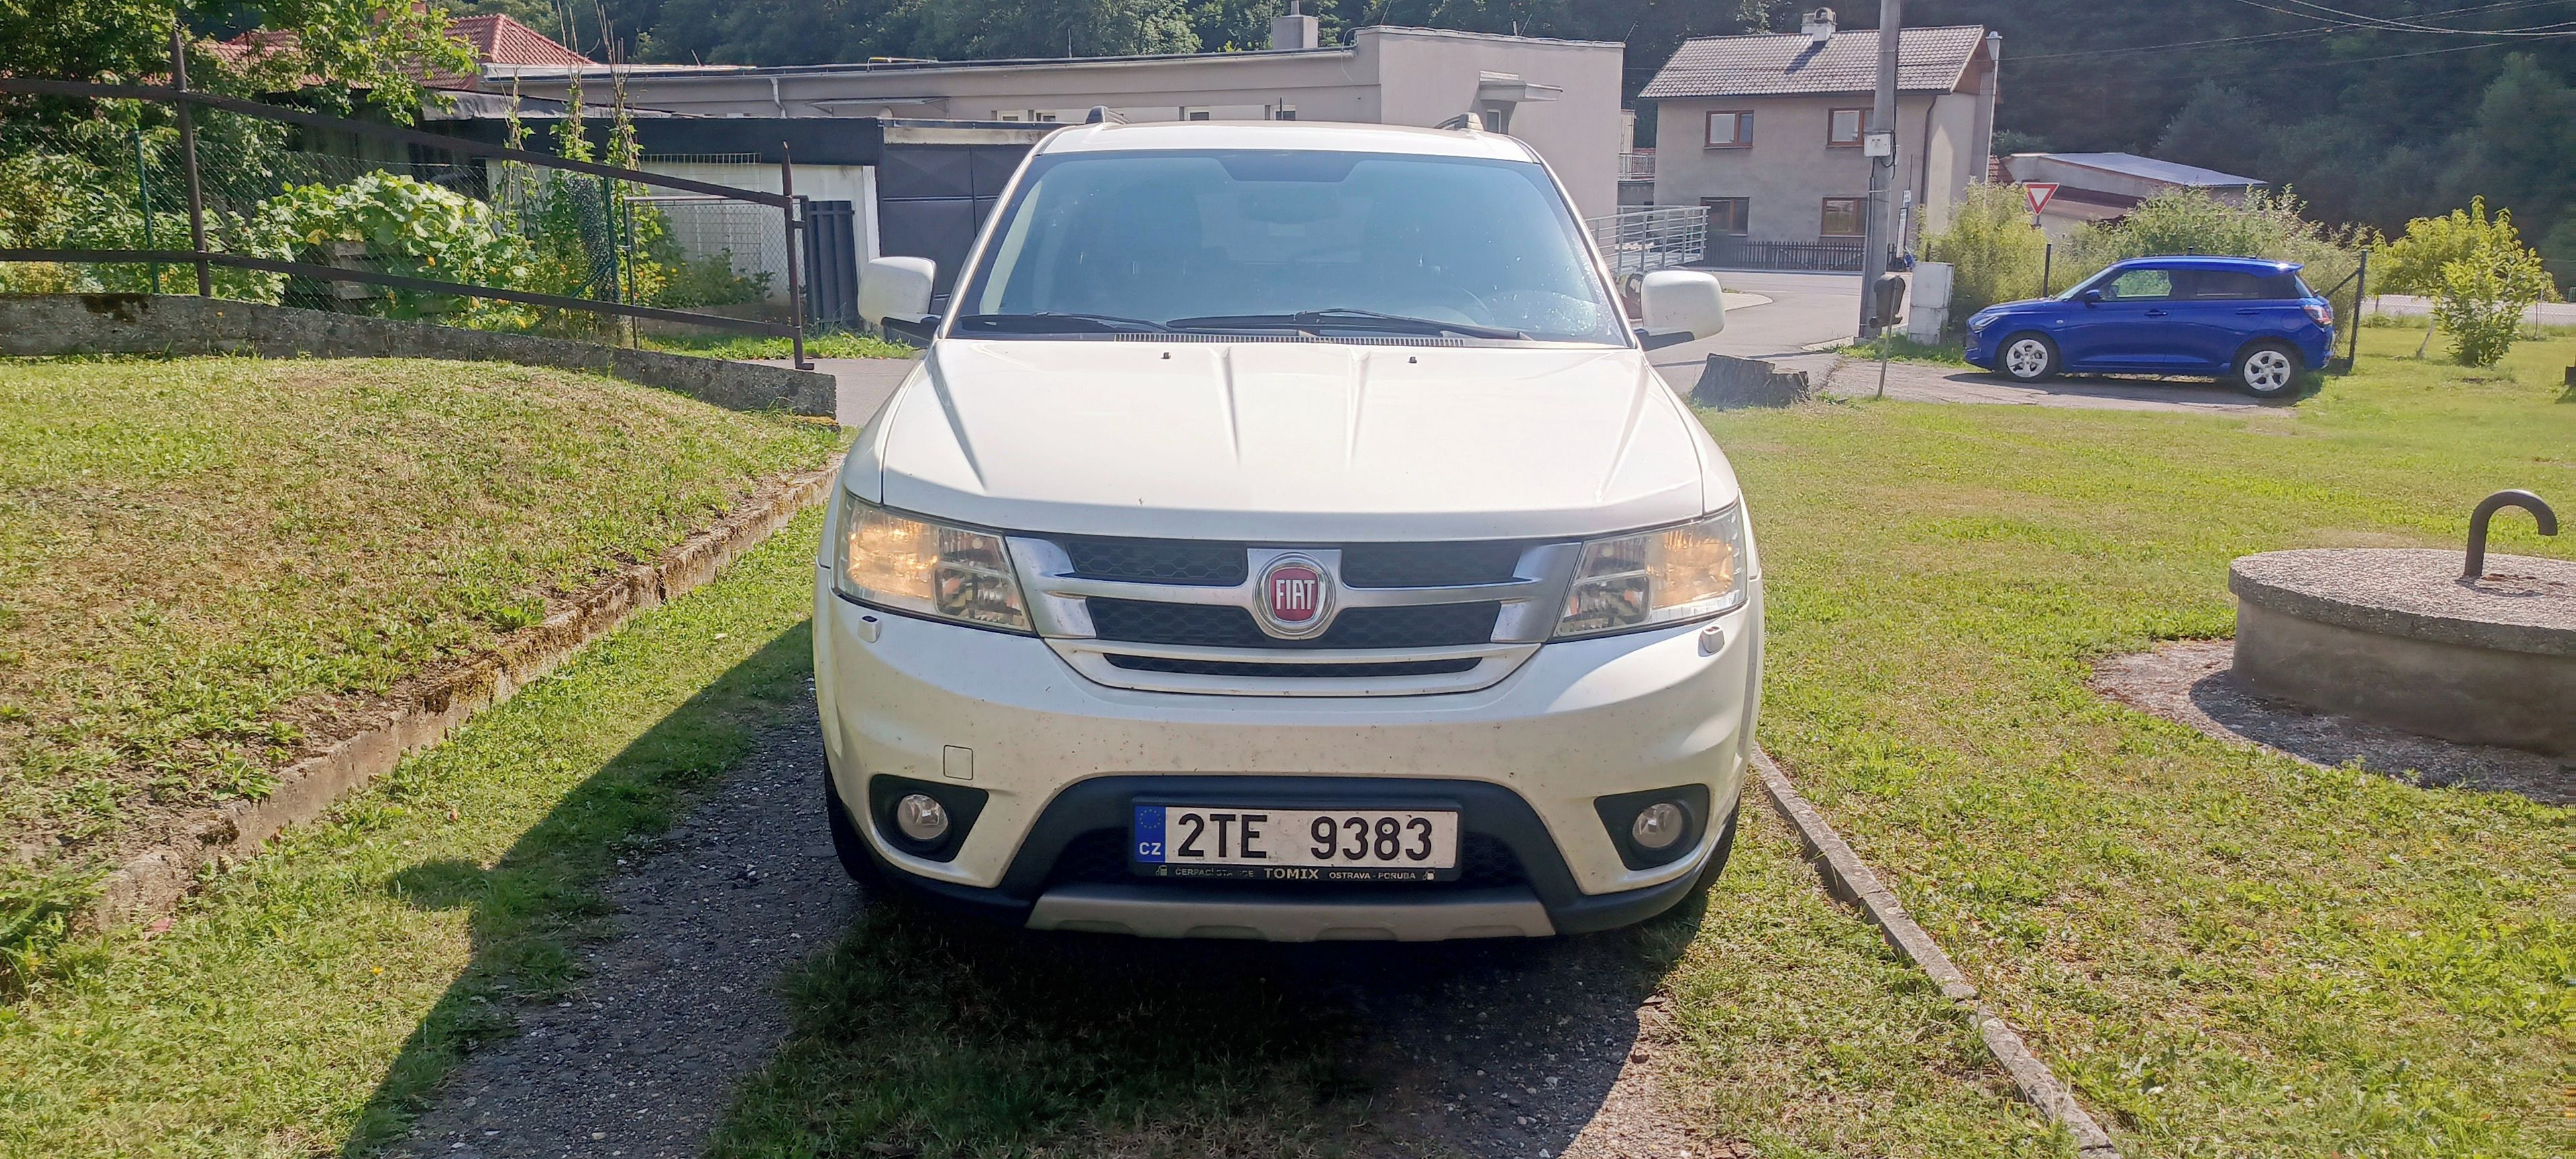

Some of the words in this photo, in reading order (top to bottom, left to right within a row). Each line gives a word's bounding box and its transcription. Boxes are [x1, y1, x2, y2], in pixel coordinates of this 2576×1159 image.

[1276, 580, 1315, 610] FIAT
[1178, 813, 1267, 858] 2TE
[1311, 816, 1432, 861] 9383
[1139, 842, 1161, 855] CZ
[1263, 868, 1319, 879] TOMIX
